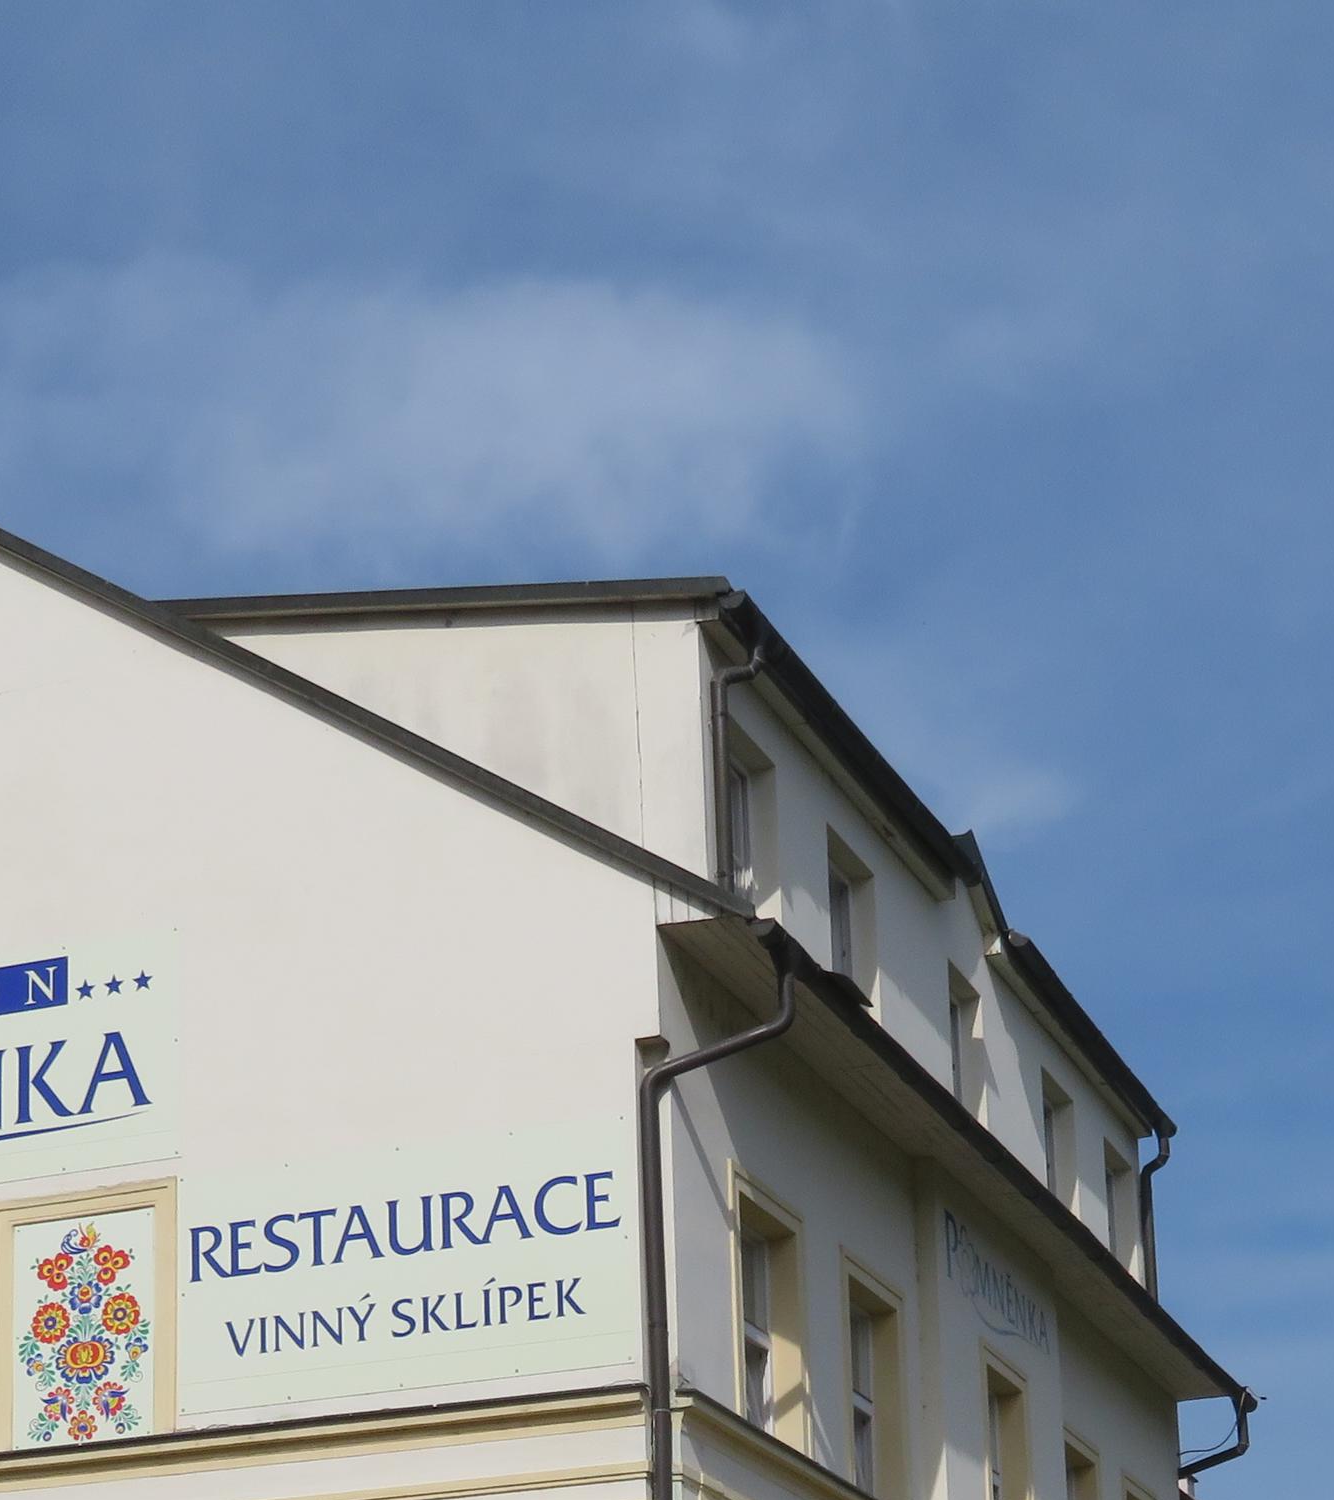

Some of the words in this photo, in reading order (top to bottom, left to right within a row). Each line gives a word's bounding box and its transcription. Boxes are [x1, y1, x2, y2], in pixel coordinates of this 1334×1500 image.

[188, 1170, 622, 1283] RESTAURACE
[224, 1292, 377, 1358] VINNÝ
[390, 1276, 587, 1338] SKLÍPEK
